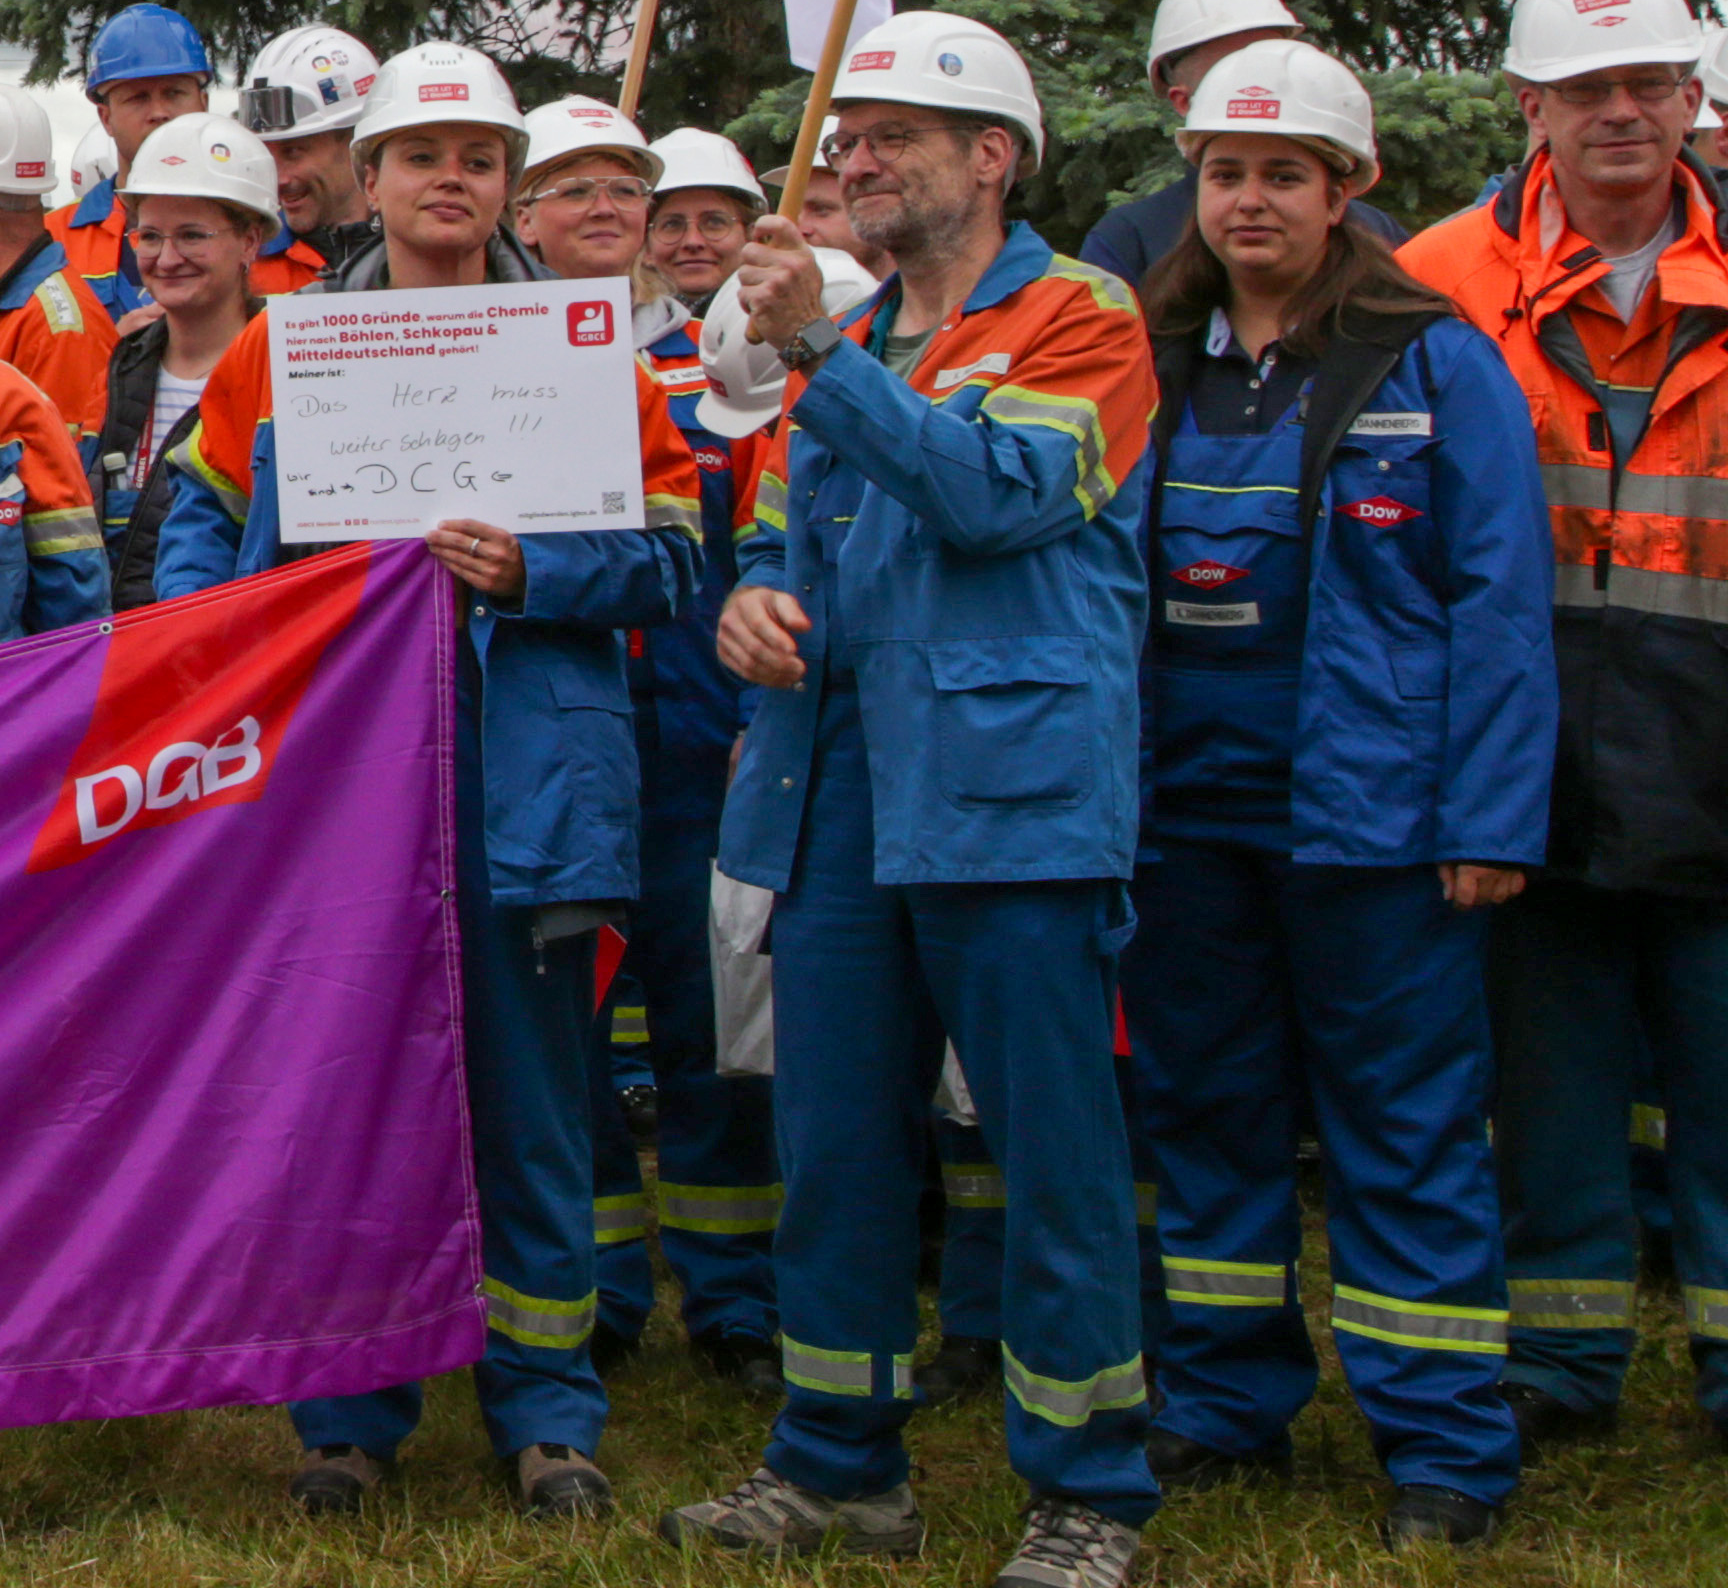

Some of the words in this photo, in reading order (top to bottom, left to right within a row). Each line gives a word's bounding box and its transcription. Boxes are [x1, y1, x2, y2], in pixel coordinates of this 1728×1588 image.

[285, 320, 297, 330] Es
[298, 320, 321, 331] gibt
[322, 315, 358, 327] 1000
[426, 313, 465, 322] warum
[467, 310, 484, 320] die
[487, 303, 549, 318] Chemie
[286, 336, 308, 346] hier
[309, 335, 337, 345] nach
[339, 329, 400, 344] Böhlen,
[402, 325, 484, 341] Schkopau
[487, 323, 499, 336] &
[576, 332, 606, 342] IGBCE
[287, 344, 436, 362] Mitteldeutschland
[438, 344, 480, 358] gehört!
[288, 369, 326, 380] Meiner
[327, 369, 346, 378] ist:
[291, 394, 348, 418] Das
[392, 382, 459, 408] Herz
[491, 384, 559, 401] muss
[329, 435, 392, 456] weiter
[74, 715, 262, 846] DGB
